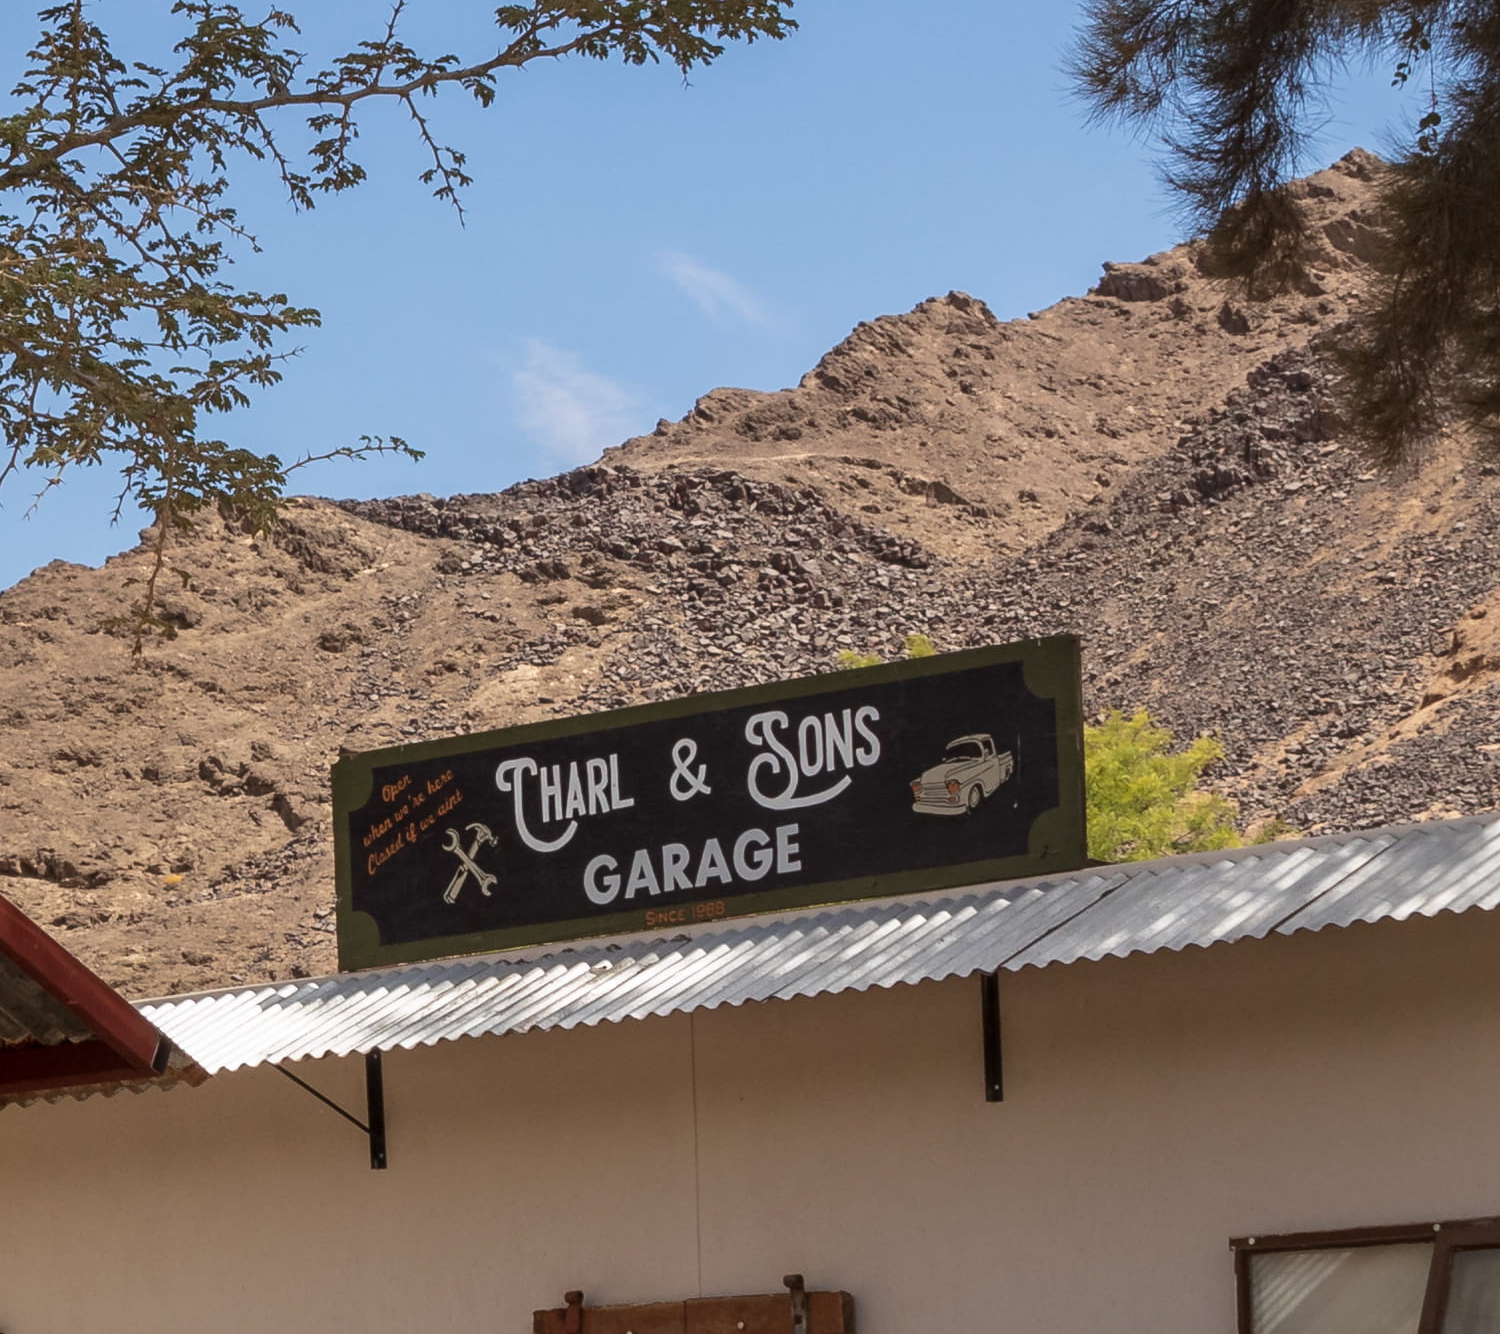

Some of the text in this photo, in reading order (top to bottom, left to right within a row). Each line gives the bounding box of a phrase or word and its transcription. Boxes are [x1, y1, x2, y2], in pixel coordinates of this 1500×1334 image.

[363, 818, 393, 847] when
[427, 769, 455, 795] here
[382, 774, 412, 802] Open
[495, 705, 881, 853] CHARL & SONS
[368, 832, 405, 876] Closed
[405, 822, 418, 843] if
[420, 814, 436, 831] we
[583, 822, 802, 905] GARAGE
[645, 908, 686, 927] SINCE
